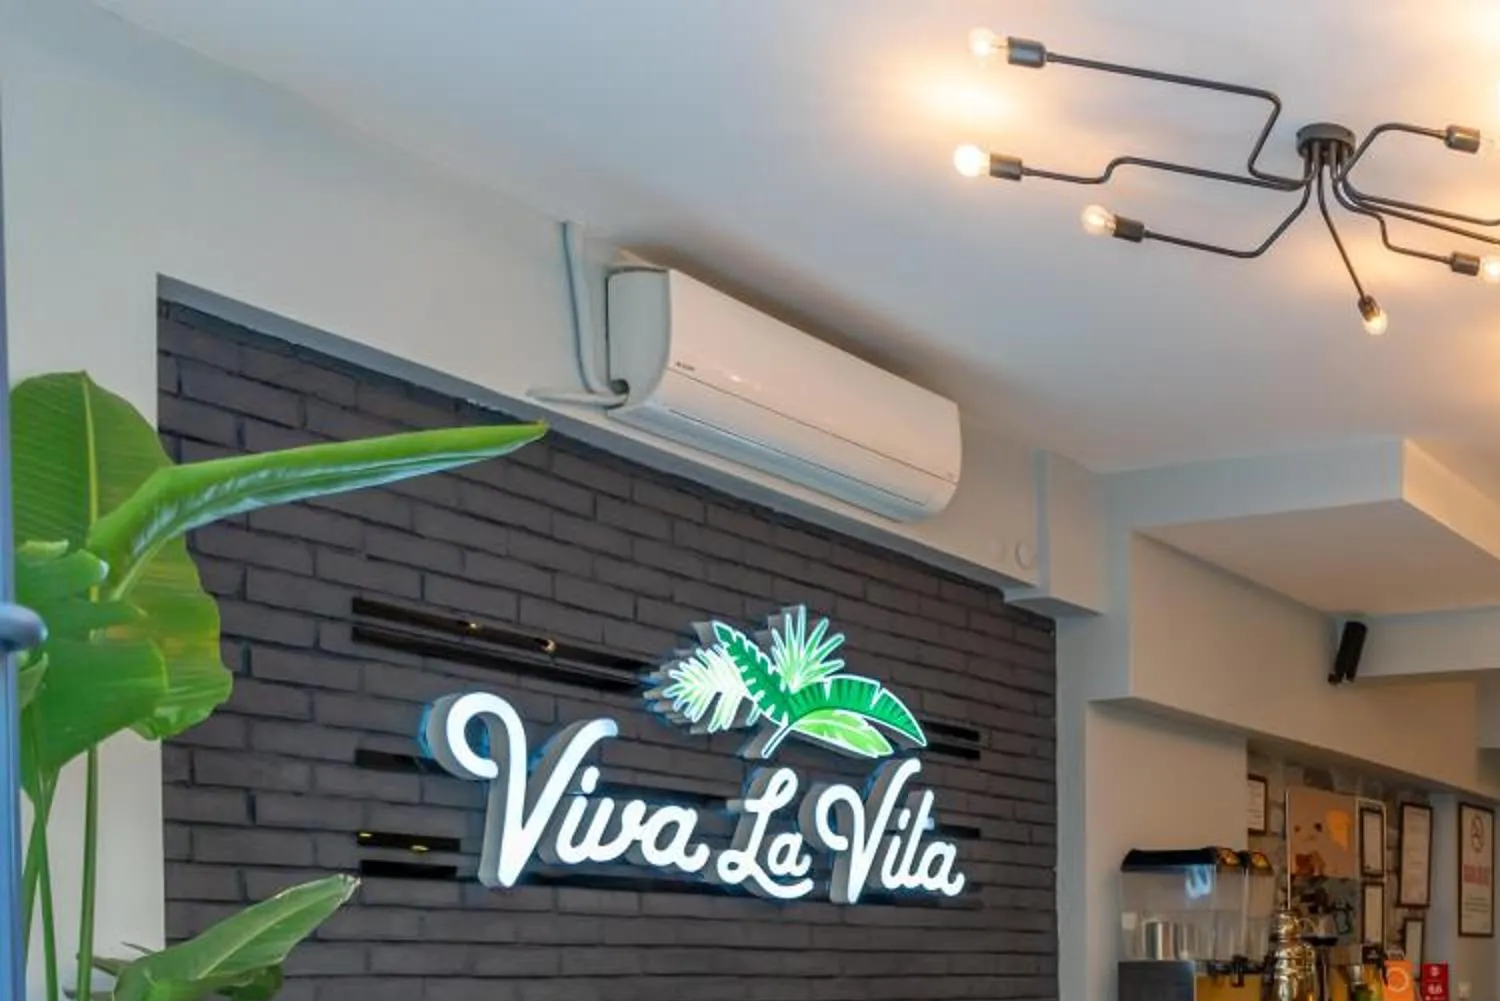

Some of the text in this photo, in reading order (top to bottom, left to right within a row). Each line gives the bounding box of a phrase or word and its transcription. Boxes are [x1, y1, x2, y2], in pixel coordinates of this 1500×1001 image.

[445, 691, 965, 904] Viva La Vita
